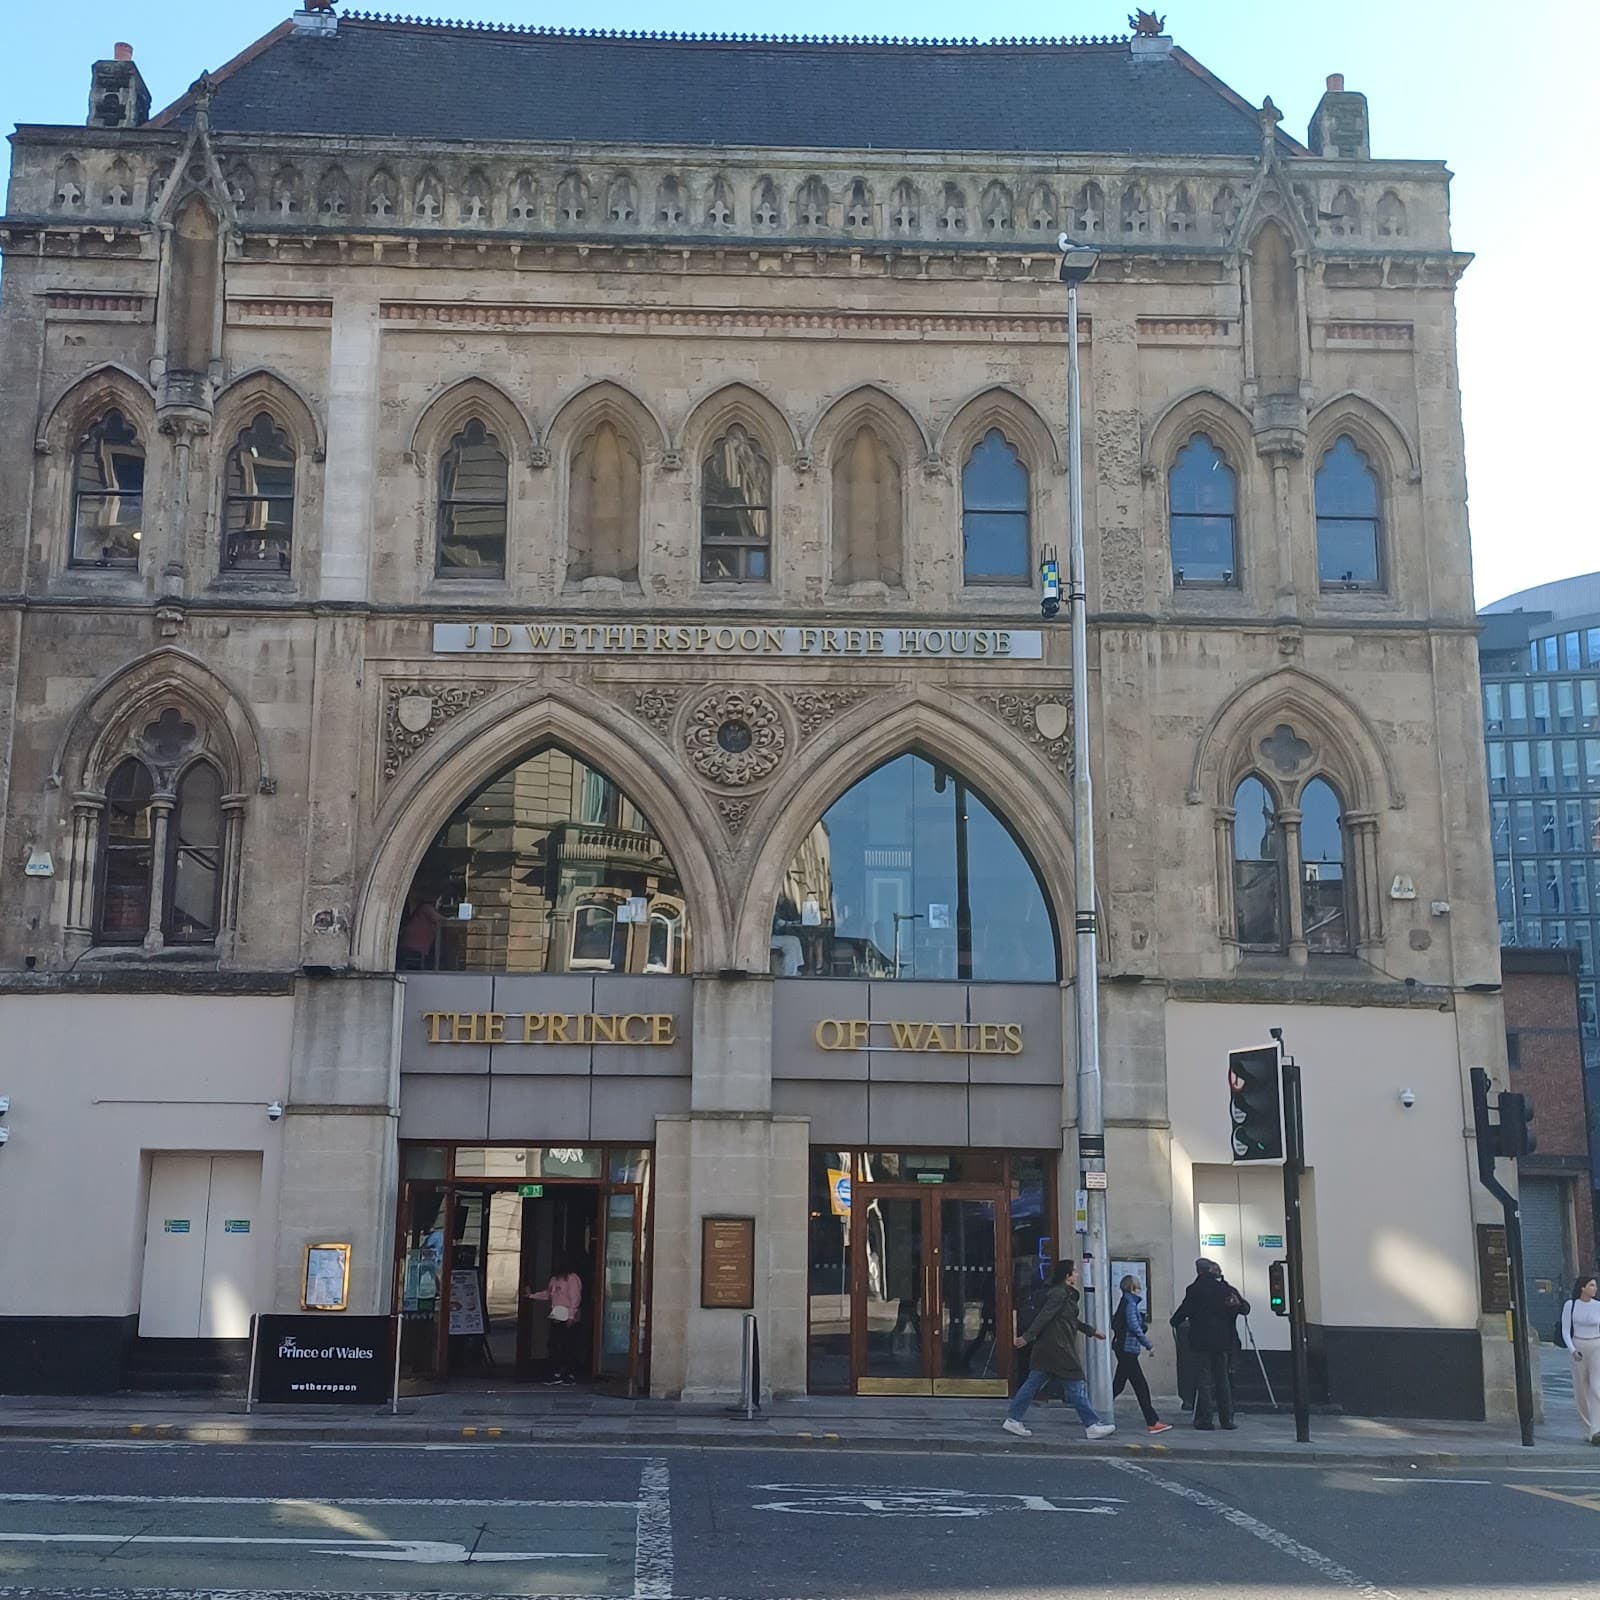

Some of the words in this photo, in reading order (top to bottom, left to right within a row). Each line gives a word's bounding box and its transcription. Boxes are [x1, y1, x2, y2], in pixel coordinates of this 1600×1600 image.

[465, 624, 479, 649] J
[490, 625, 513, 649] D
[524, 625, 786, 652] WETHERSPOON
[799, 629, 886, 653] FREE
[899, 630, 1012, 655] HOUSE
[423, 1012, 506, 1043] THE
[523, 1013, 677, 1045] PRINCE
[815, 1019, 870, 1051] OF
[890, 1021, 1025, 1054] WALES
[278, 1346, 319, 1359] Prince
[320, 1346, 335, 1359] of
[336, 1346, 374, 1359] Wales
[291, 1382, 357, 1393] wetherspoon
